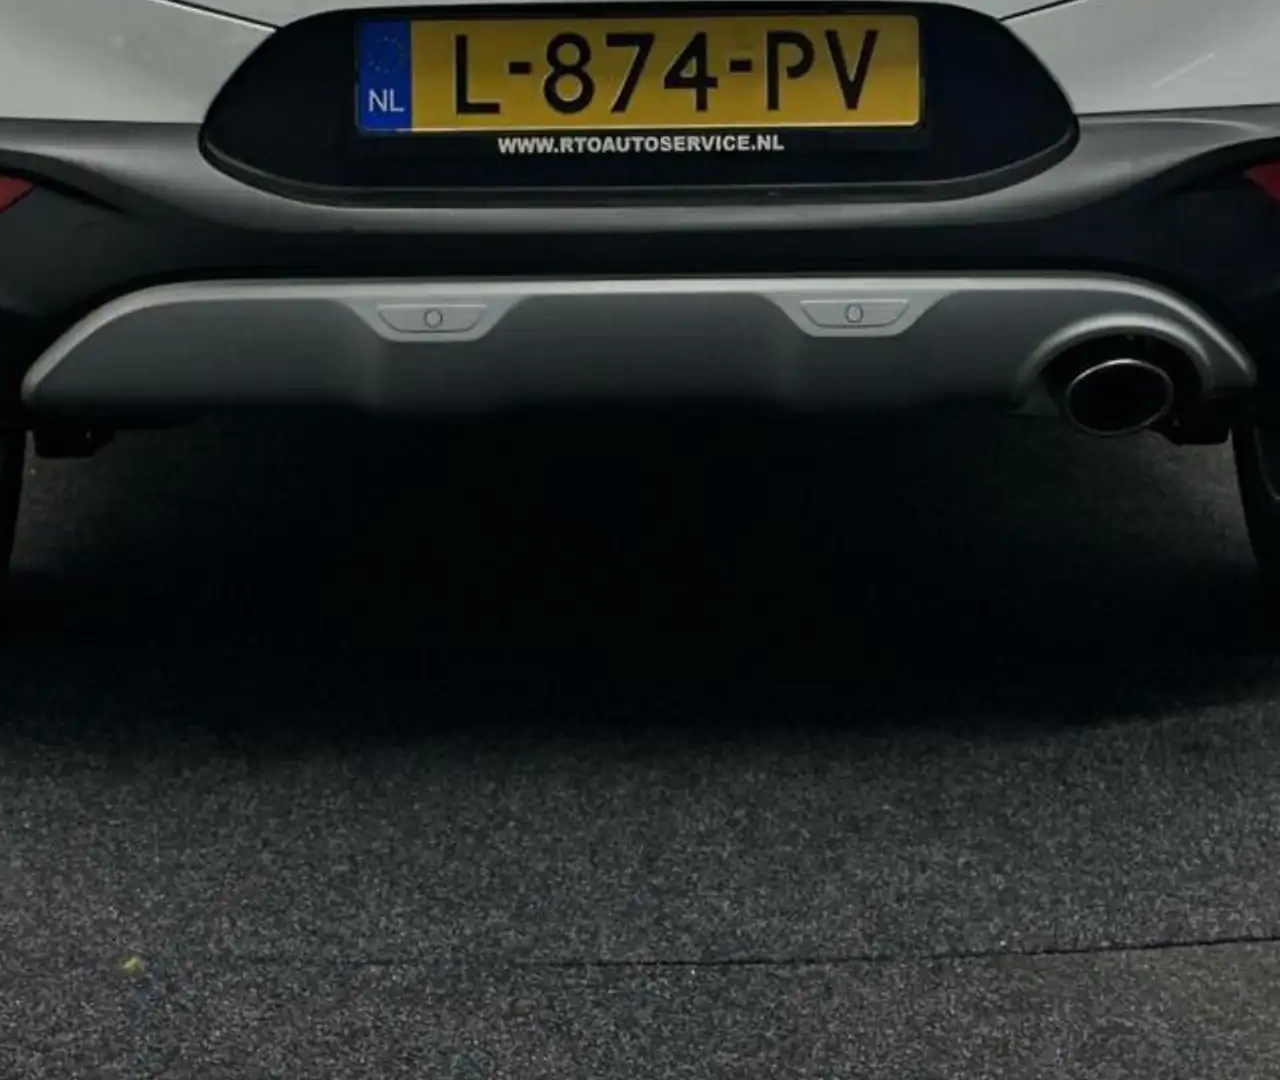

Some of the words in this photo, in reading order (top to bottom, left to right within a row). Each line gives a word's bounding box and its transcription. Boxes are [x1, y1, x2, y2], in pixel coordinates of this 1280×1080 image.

[453, 29, 879, 115] L-874-PV
[368, 88, 404, 113] NL
[497, 133, 785, 154] WWW.RTOAUTOSERVICE.NL
